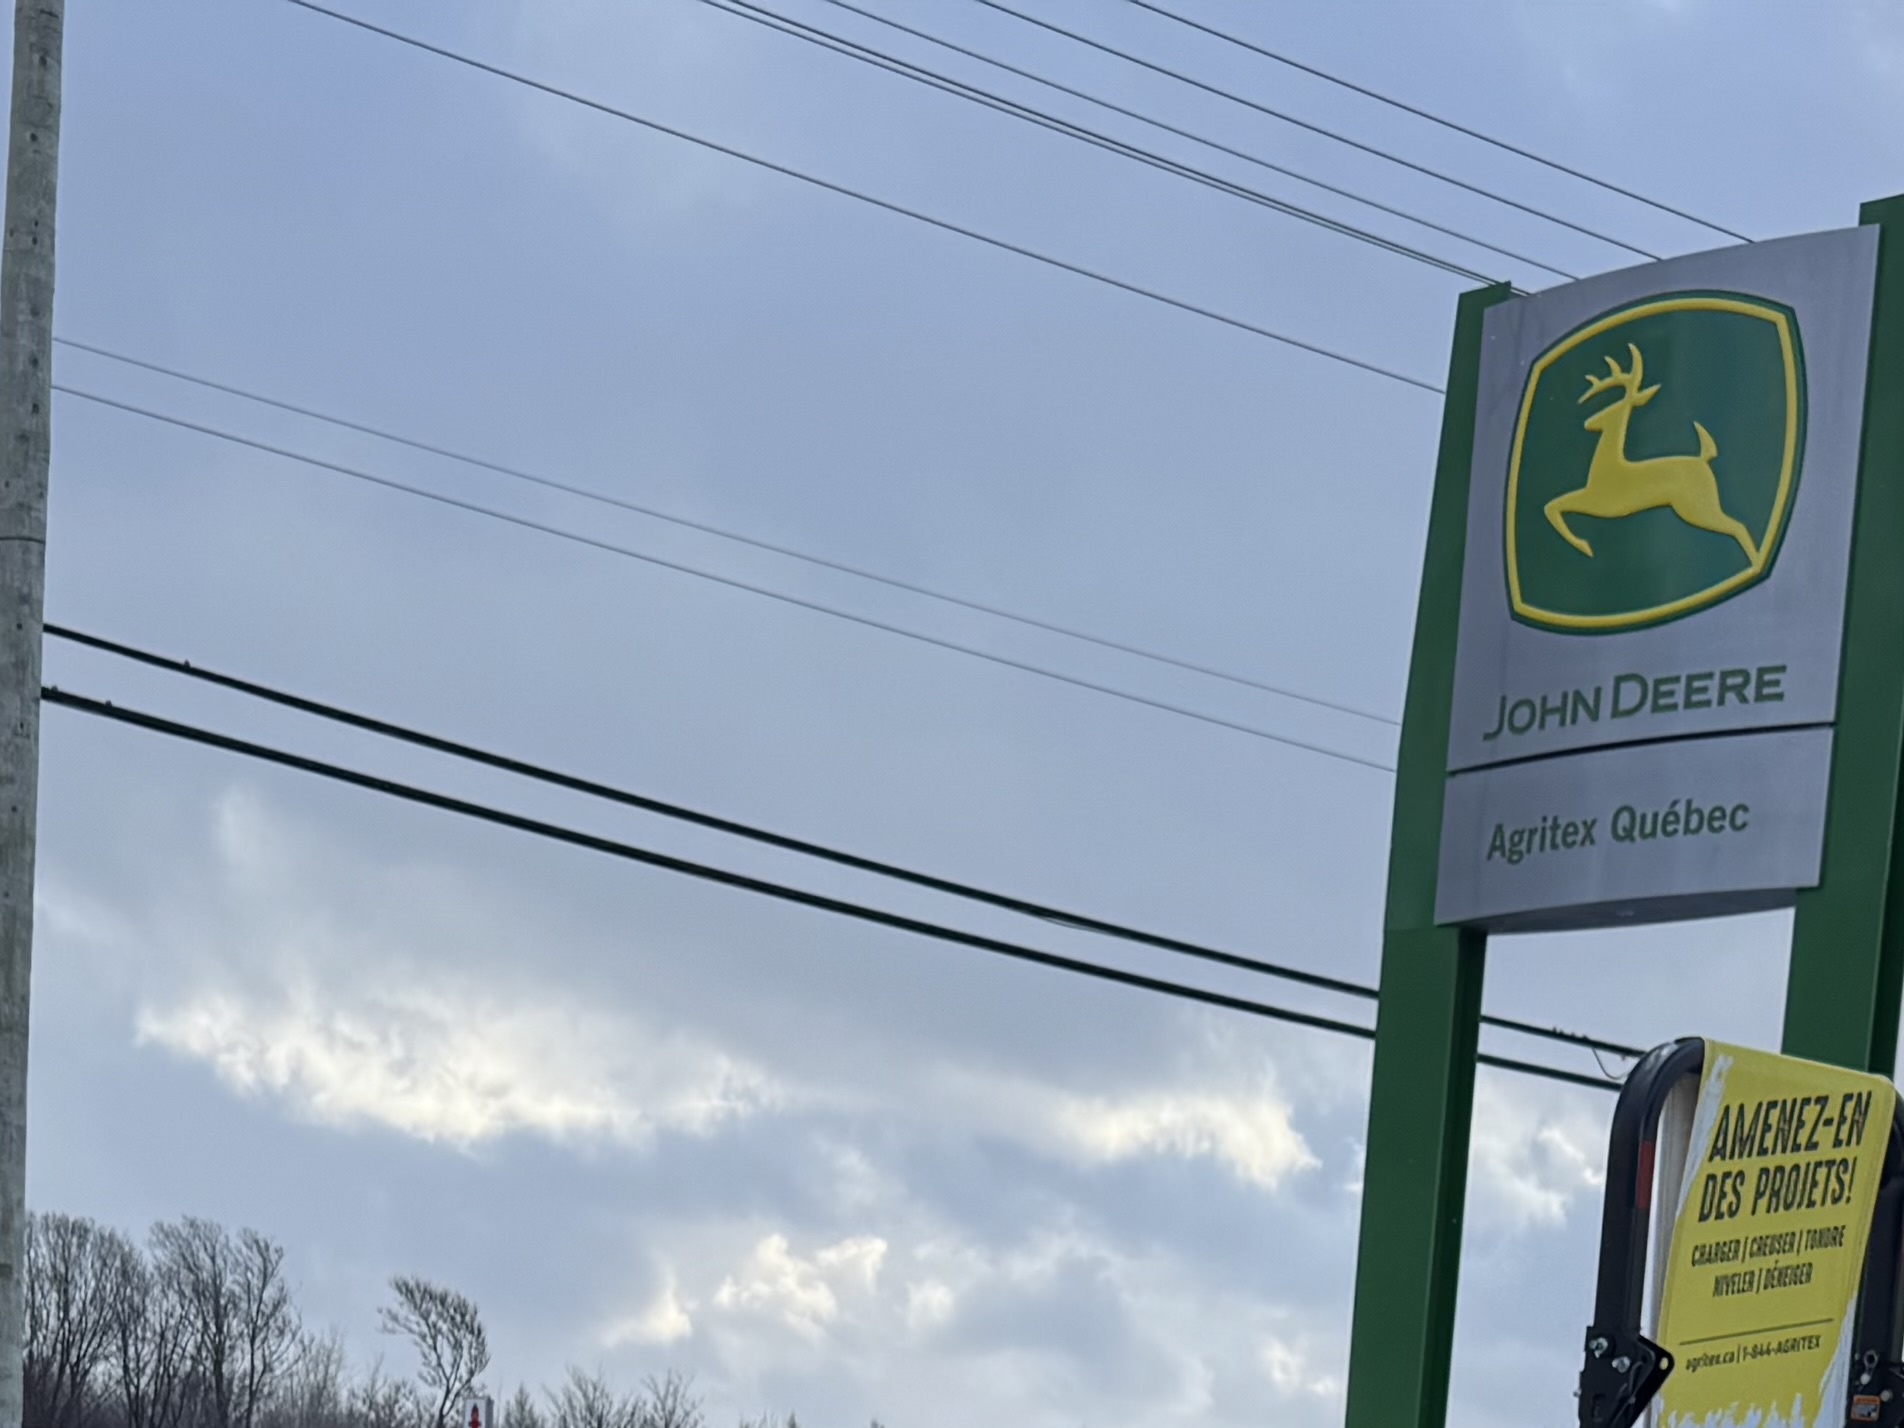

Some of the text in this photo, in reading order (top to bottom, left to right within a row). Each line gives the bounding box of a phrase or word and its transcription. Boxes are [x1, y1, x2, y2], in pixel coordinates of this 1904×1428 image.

[1484, 664, 1788, 741] JOHN DEERE
[1487, 796, 1750, 866] Agritex Québec
[1708, 1090, 1873, 1163] AMENEZ-EN
[1698, 1156, 1858, 1224] DES PROJETS!
[1691, 1239, 1741, 1267] CHARGER
[1749, 1231, 1796, 1258] CREUSER
[1804, 1225, 1846, 1251] TONDRE
[1712, 1269, 1755, 1297] NIVELER
